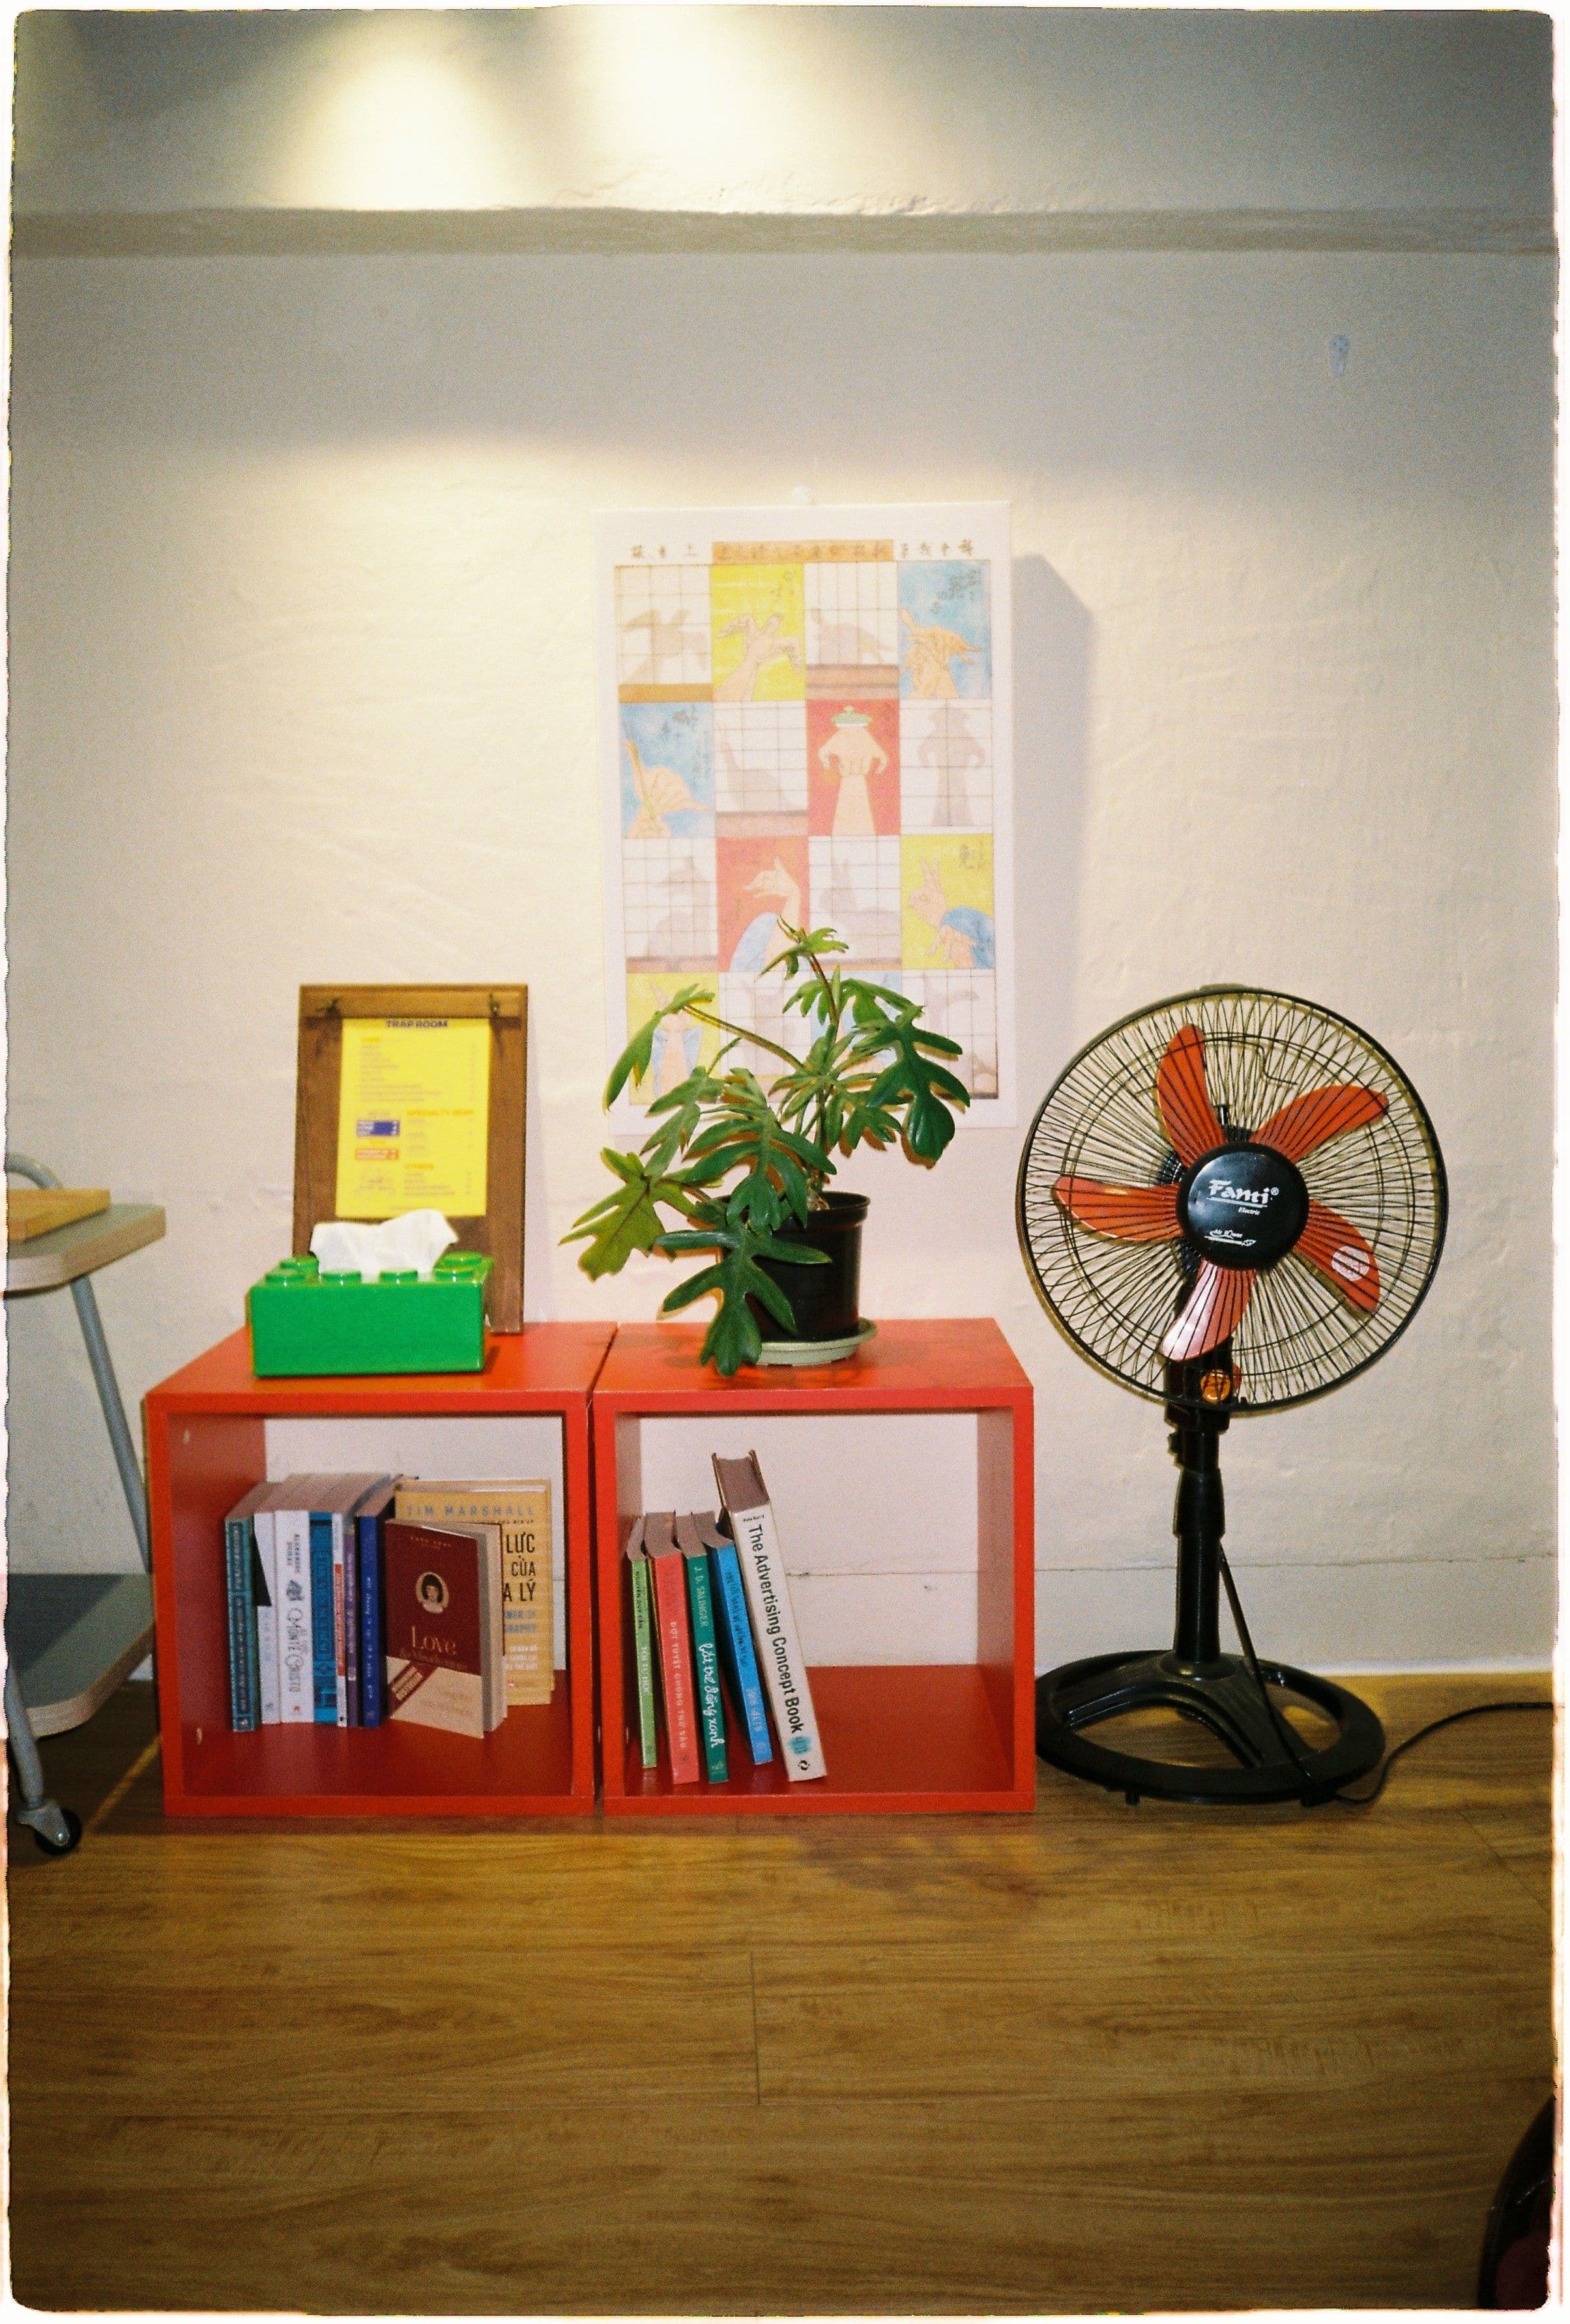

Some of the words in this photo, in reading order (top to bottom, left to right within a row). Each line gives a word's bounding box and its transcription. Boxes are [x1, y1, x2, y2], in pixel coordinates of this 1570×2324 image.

[406, 1505, 434, 1515] TIM
[444, 1505, 534, 1516] MARSHALL
[749, 1524, 764, 1552] The
[519, 1578, 536, 1601] LÝ
[754, 1555, 781, 1635] Advertising
[772, 1637, 796, 1696] Concept
[785, 1696, 804, 1734] Book
[707, 1717, 725, 1748] xanh
